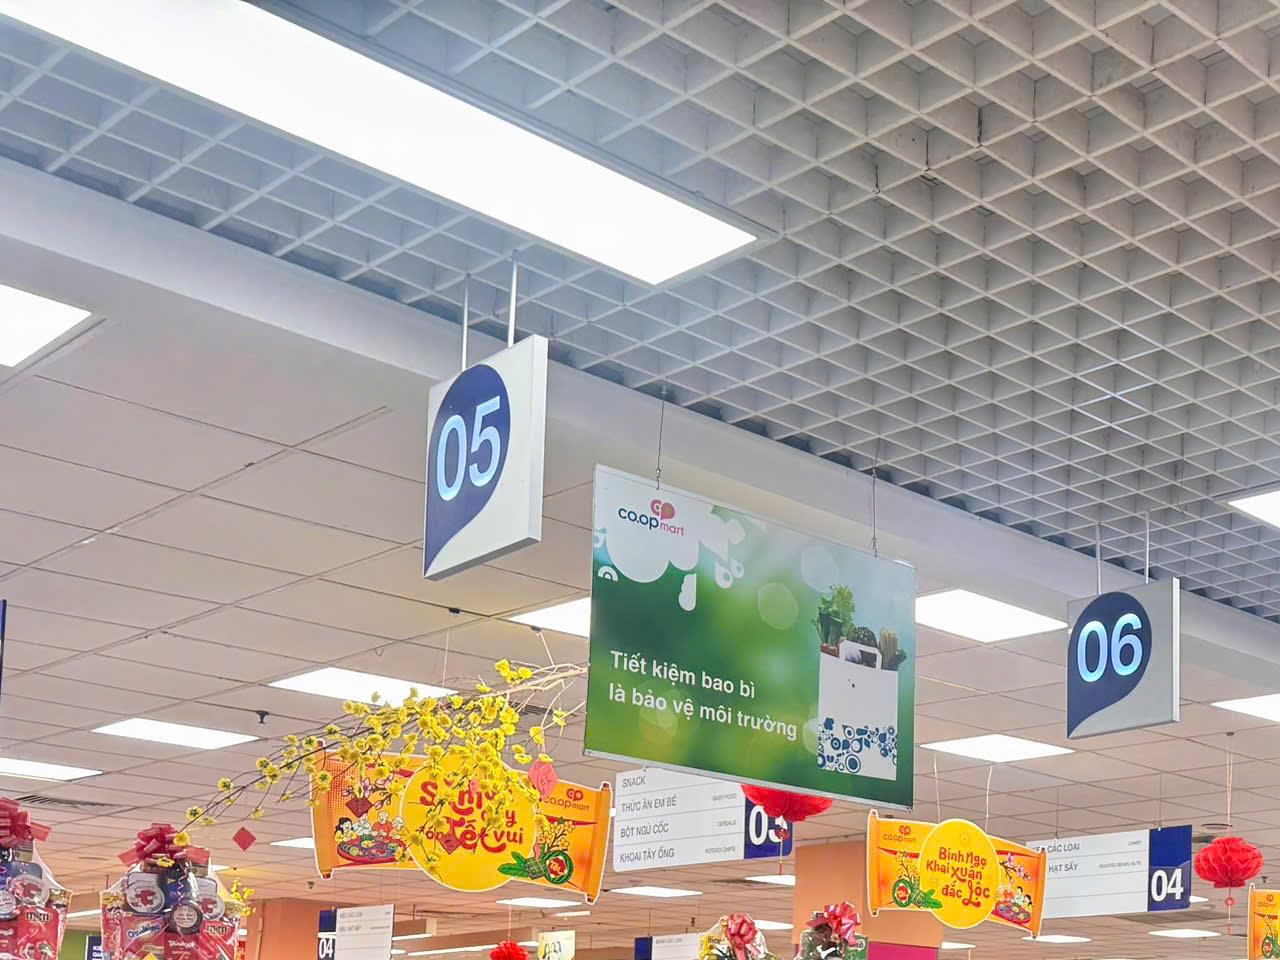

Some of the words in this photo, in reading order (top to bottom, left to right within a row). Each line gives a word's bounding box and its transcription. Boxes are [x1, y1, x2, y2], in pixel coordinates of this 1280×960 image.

[435, 396, 501, 502] 05
[1076, 612, 1143, 682] 06
[610, 650, 646, 674] Tiết
[651, 656, 696, 683] kiệm
[702, 671, 734, 694] bao
[740, 677, 755, 698] bì
[608, 683, 627, 703] là
[632, 684, 667, 711] bảo
[672, 694, 694, 718] vệ
[700, 702, 732, 725] môi
[737, 710, 797, 740] trường
[622, 775, 646, 788] SNACK
[621, 799, 641, 814] THỨC
[642, 797, 653, 811] ĂN
[654, 798, 665, 809] EM
[666, 795, 677, 808] BÉ
[494, 827, 524, 844] vui
[620, 826, 635, 839] BỘT
[652, 822, 669, 835] CỐC
[620, 851, 641, 864] KHOAI
[643, 848, 658, 861] TÂY
[659, 846, 675, 860] ỐNG
[938, 846, 964, 863] Bính
[1048, 842, 1062, 854] CÁC
[1063, 843, 1080, 853] LOẠI
[926, 858, 950, 874] Khai
[1049, 863, 1063, 874] HẠT
[1064, 861, 1079, 873] SẤY
[941, 881, 962, 899] đắc
[1151, 868, 1184, 902] 04
[319, 937, 333, 959] 04
